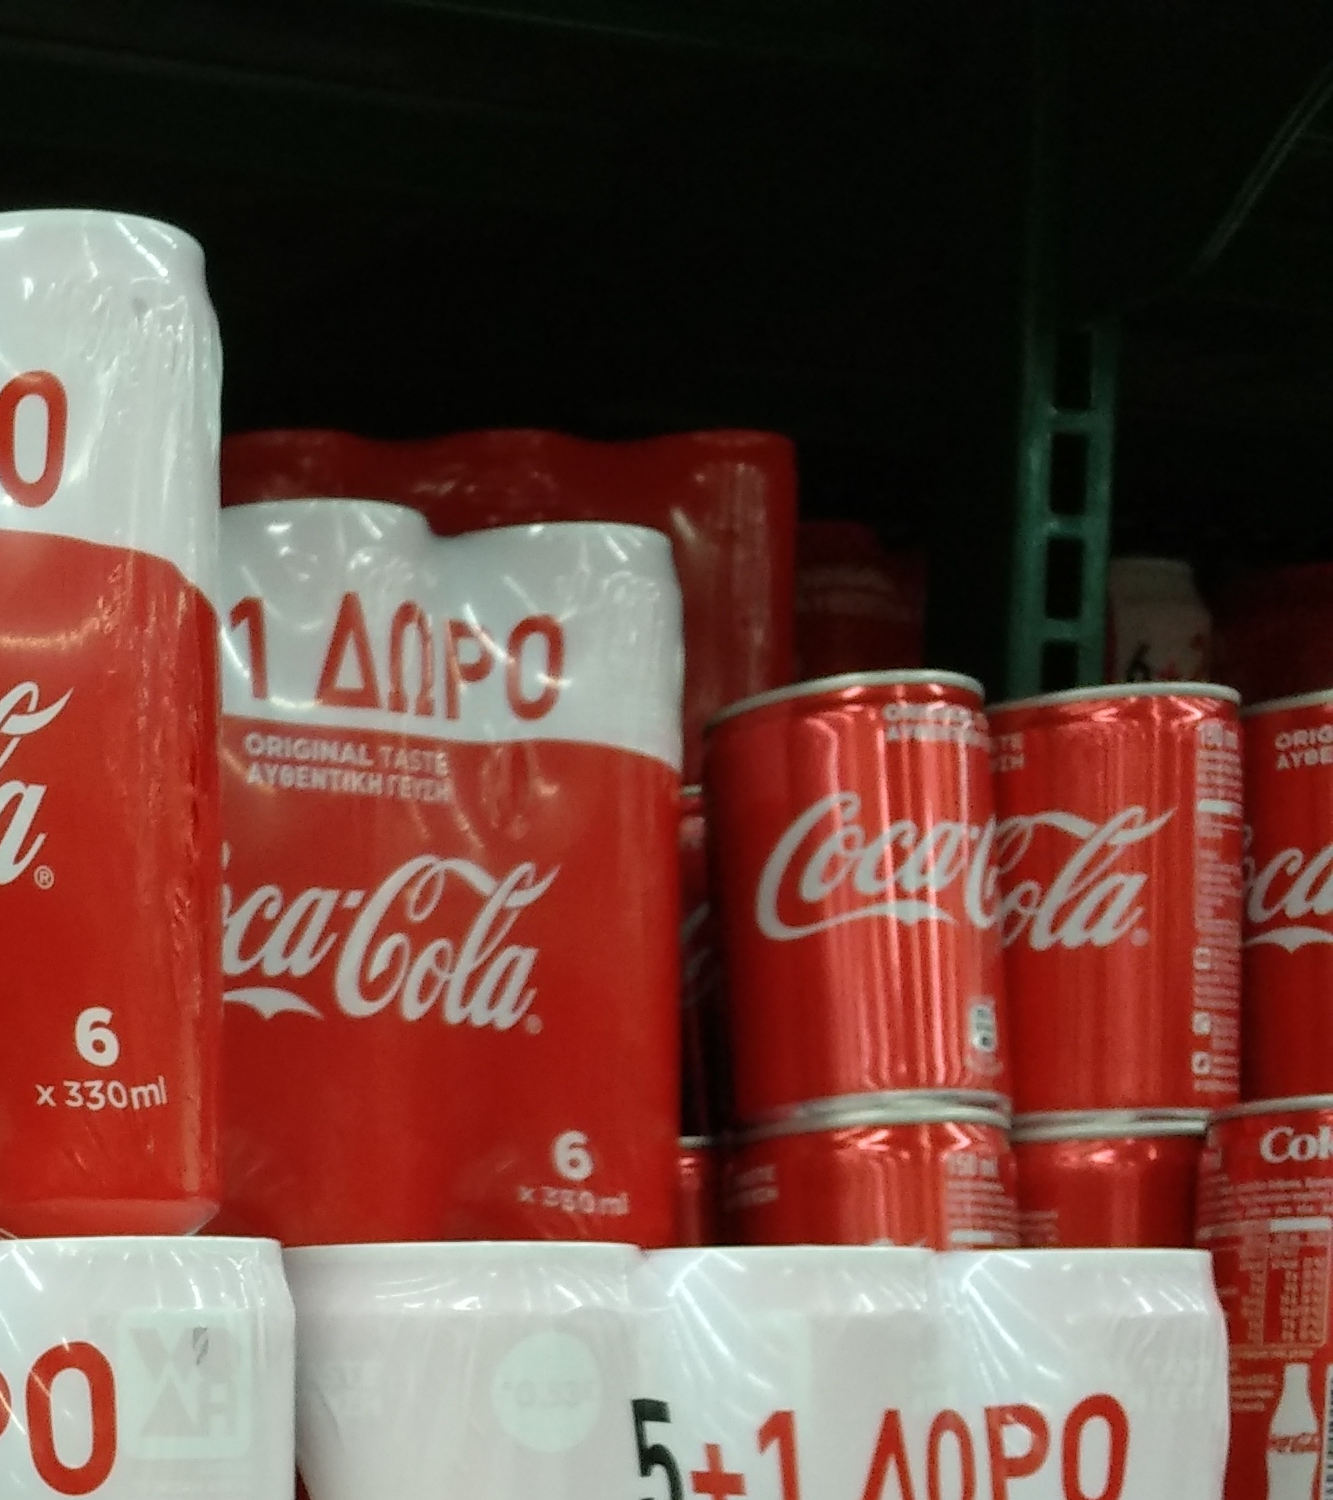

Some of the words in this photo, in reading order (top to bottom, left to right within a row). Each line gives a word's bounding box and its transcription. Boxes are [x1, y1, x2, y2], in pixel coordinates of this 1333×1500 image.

[315, 591, 564, 721] ΔΩΡΟ
[75, 1006, 120, 1067] 6
[553, 1130, 595, 1181] 6
[1260, 1124, 1333, 1163] Cok
